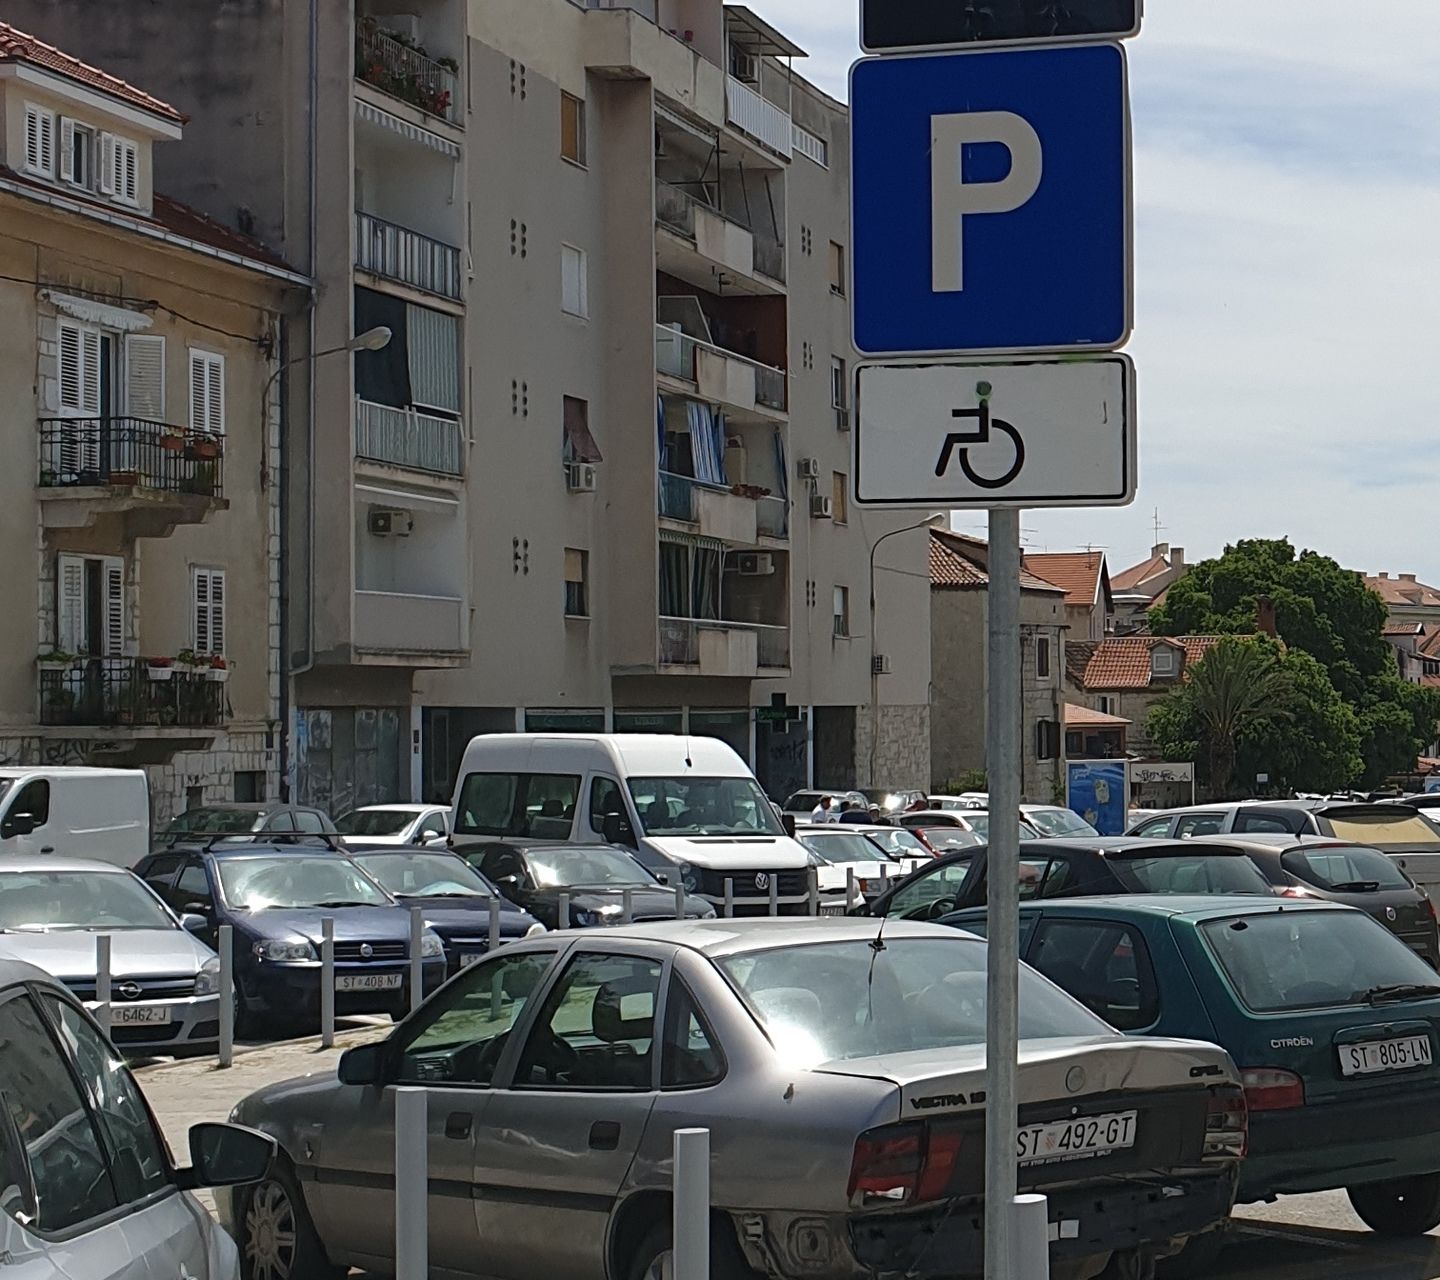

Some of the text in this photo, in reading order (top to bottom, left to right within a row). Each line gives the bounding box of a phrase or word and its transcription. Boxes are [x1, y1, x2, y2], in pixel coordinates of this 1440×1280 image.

[930, 110, 1043, 292] P
[1350, 1038, 1430, 1069] ST 805-LN
[910, 1093, 967, 1110] VECTRA
[1017, 1116, 1133, 1157] ST 492-GT
